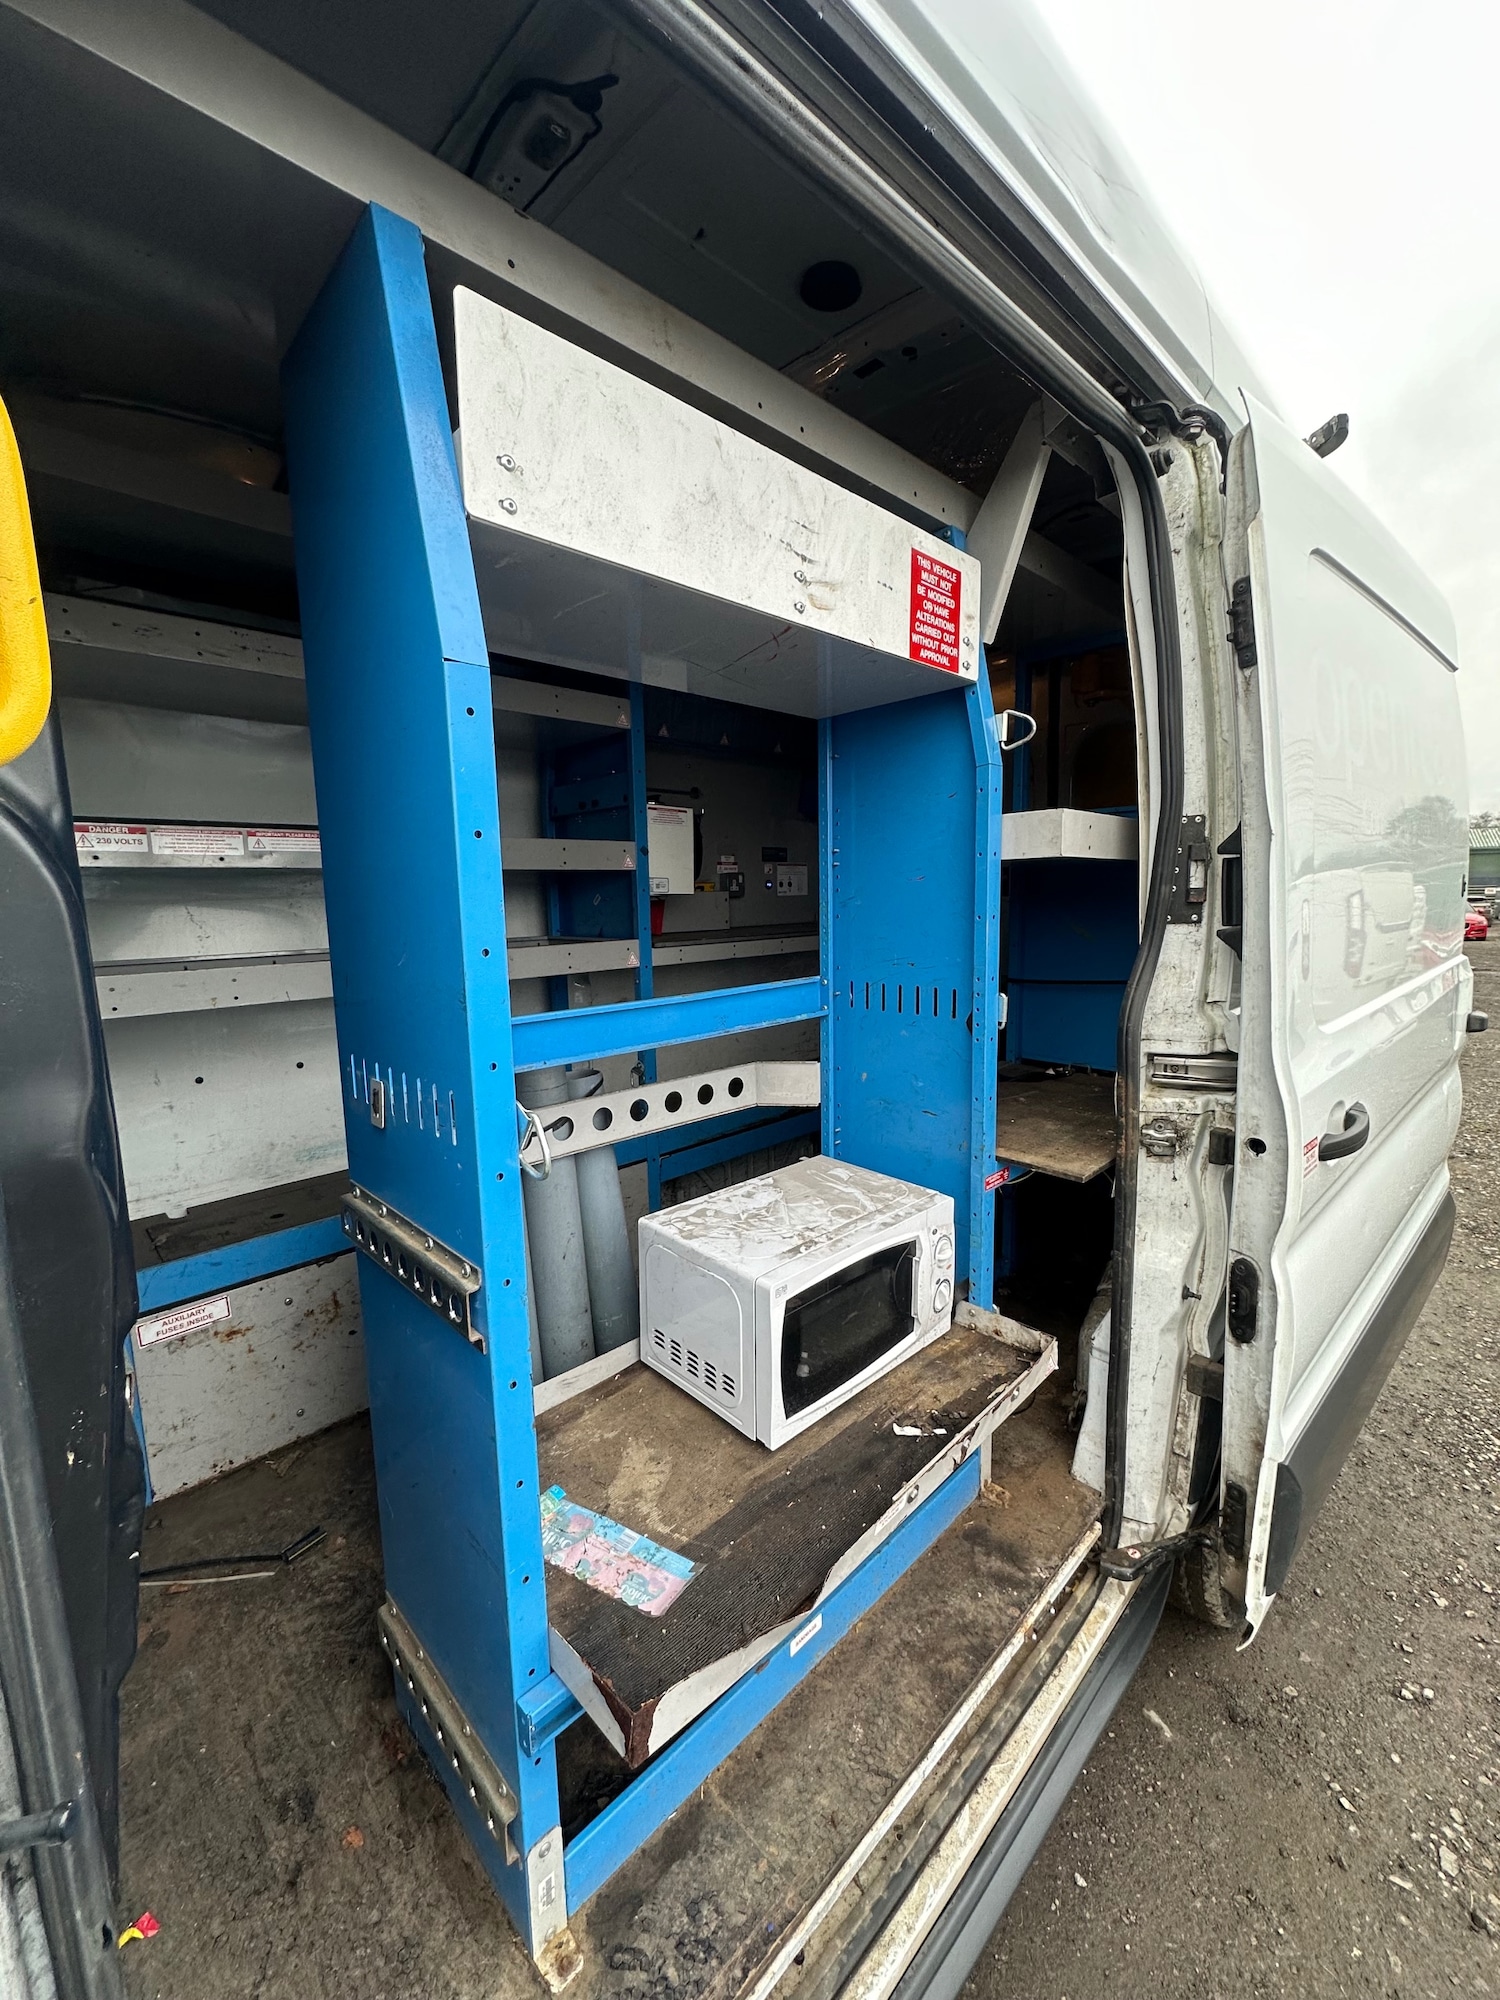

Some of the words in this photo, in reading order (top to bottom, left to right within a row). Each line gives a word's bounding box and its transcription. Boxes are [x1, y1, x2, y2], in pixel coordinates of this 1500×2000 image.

[917, 555, 931, 570] THIS
[932, 562, 957, 583] VEHICLE
[921, 570, 938, 586] MUST
[940, 579, 952, 592] NOT
[916, 584, 926, 597] BE
[927, 589, 956, 609] MODIFIED
[916, 609, 956, 633] ALTERATIONS
[923, 600, 933, 613] OR
[932, 604, 950, 619] HAVE
[915, 621, 942, 640] CARRIED
[943, 632, 956, 645] OUT
[912, 632, 939, 650] WITHOUT
[940, 643, 959, 658] PRIOR
[920, 648, 950, 666] APPROVAL
[88, 825, 129, 834] DANGER
[95, 837, 112, 845] 230
[113, 838, 144, 846] VOLTS
[156, 1322, 184, 1337] FUSES
[186, 1312, 214, 1327] INSIDE
[161, 1307, 206, 1327] AUXILIARY
